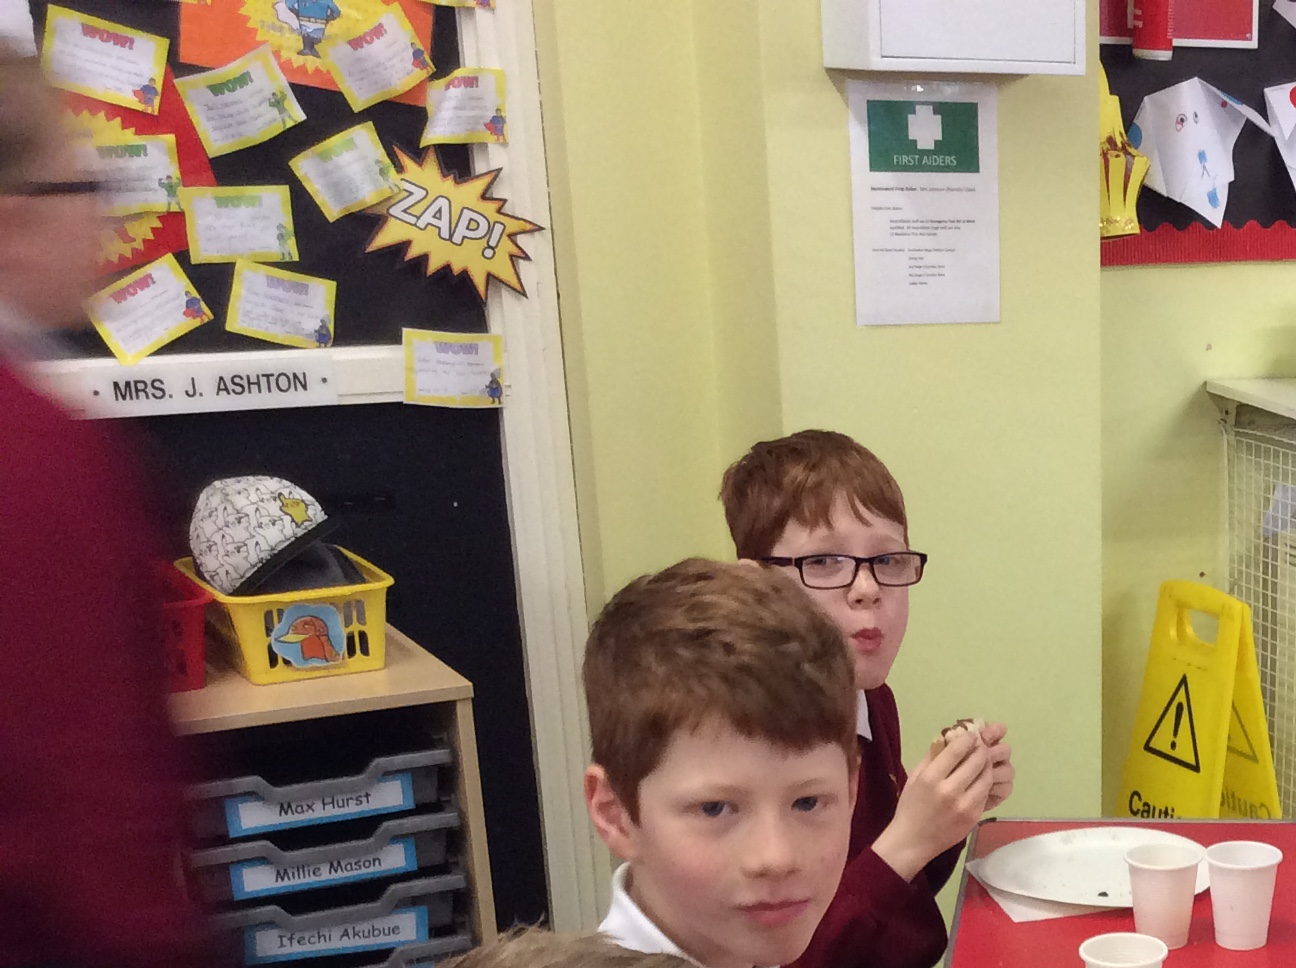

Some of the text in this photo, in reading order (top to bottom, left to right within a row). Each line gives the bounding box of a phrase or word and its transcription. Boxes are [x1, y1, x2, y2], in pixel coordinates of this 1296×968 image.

[81, 22, 136, 50] WOW!
[347, 22, 388, 51] WOW!
[206, 70, 254, 97] WOW!
[893, 154, 957, 167] FIRST AIDERS
[386, 177, 506, 260] ZAP!
[110, 272, 156, 304] WOW!
[112, 371, 309, 401] MRS. J. ASHTON
[278, 791, 372, 818] Max Hurst
[1128, 790, 1182, 819] Cauti
[274, 854, 383, 883] Millie Mason
[339, 922, 402, 943] Akubue
